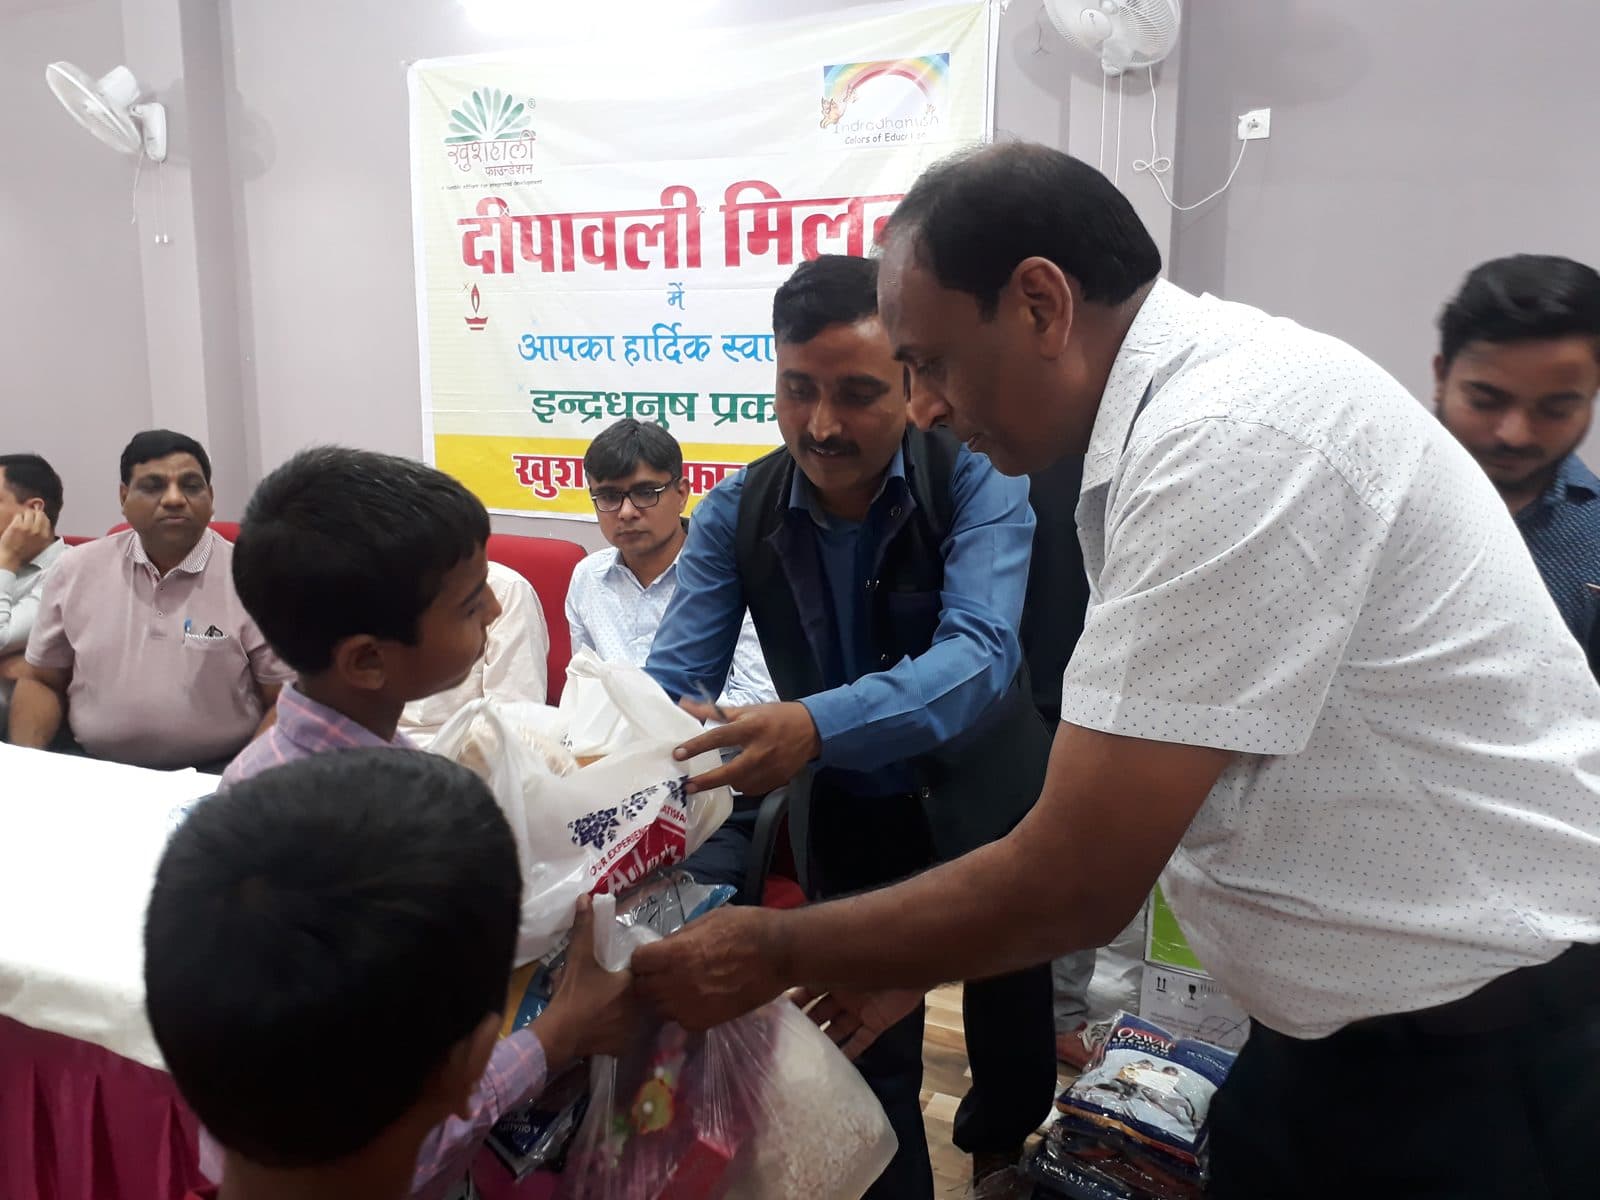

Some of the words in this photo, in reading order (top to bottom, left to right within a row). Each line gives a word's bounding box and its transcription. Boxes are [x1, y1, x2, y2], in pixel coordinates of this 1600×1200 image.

[447, 129, 537, 172] खुशहाली
[844, 133, 871, 145] Colors
[872, 133, 882, 143] of
[457, 185, 703, 275] दीपावली
[719, 180, 907, 270] मिल
[667, 282, 686, 311] में
[518, 333, 616, 361] आपका
[622, 322, 712, 367] हार्दिक
[721, 334, 775, 362] स्वा
[530, 389, 699, 430] इन्द्रधनुष
[709, 392, 778, 426] प्रक
[513, 455, 585, 498] खुश
